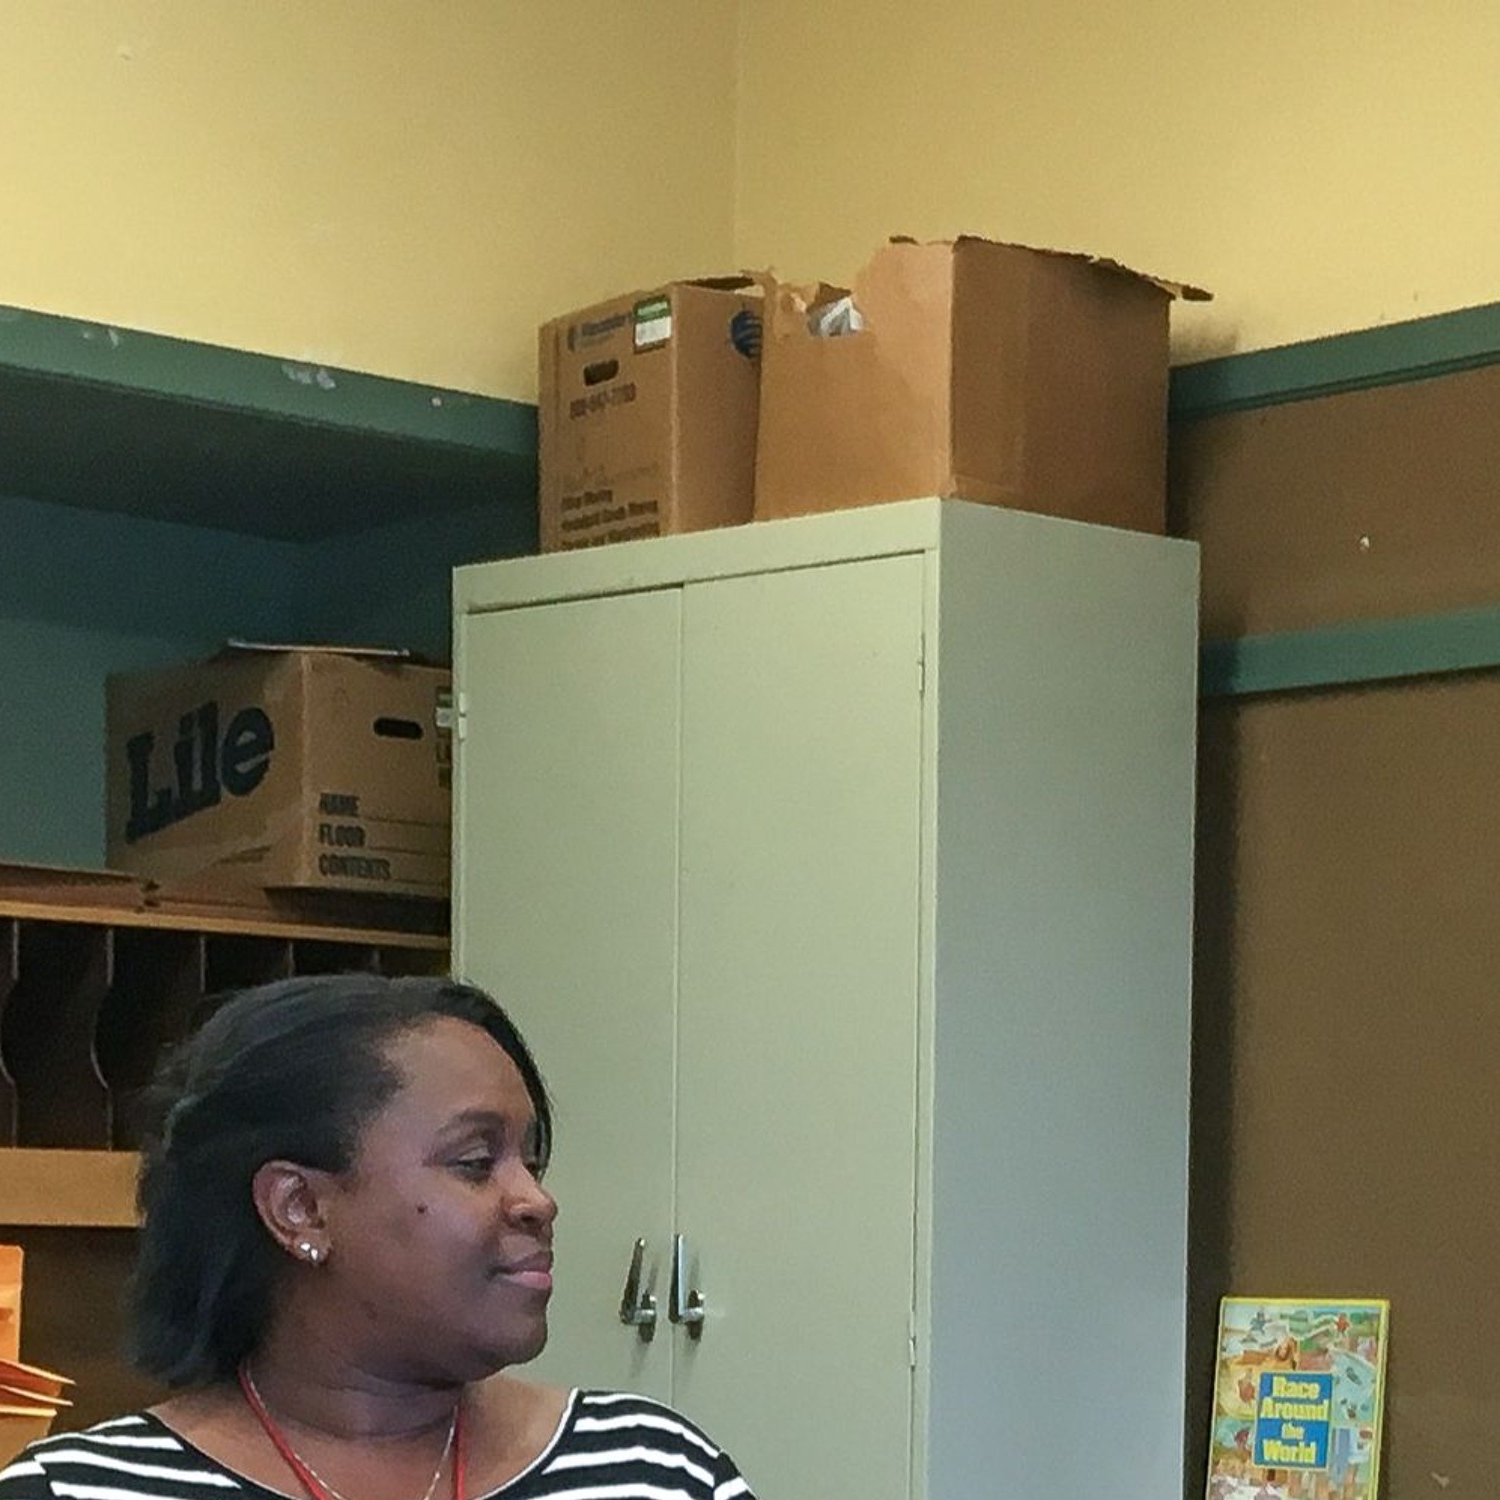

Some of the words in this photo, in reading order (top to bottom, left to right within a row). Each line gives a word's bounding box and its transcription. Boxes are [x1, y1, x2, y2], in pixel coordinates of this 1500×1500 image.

[319, 822, 366, 848] FLOOR
[319, 853, 392, 880] CONTENTS
[1260, 1397, 1330, 1421] Around
[1263, 1439, 1317, 1464] World
